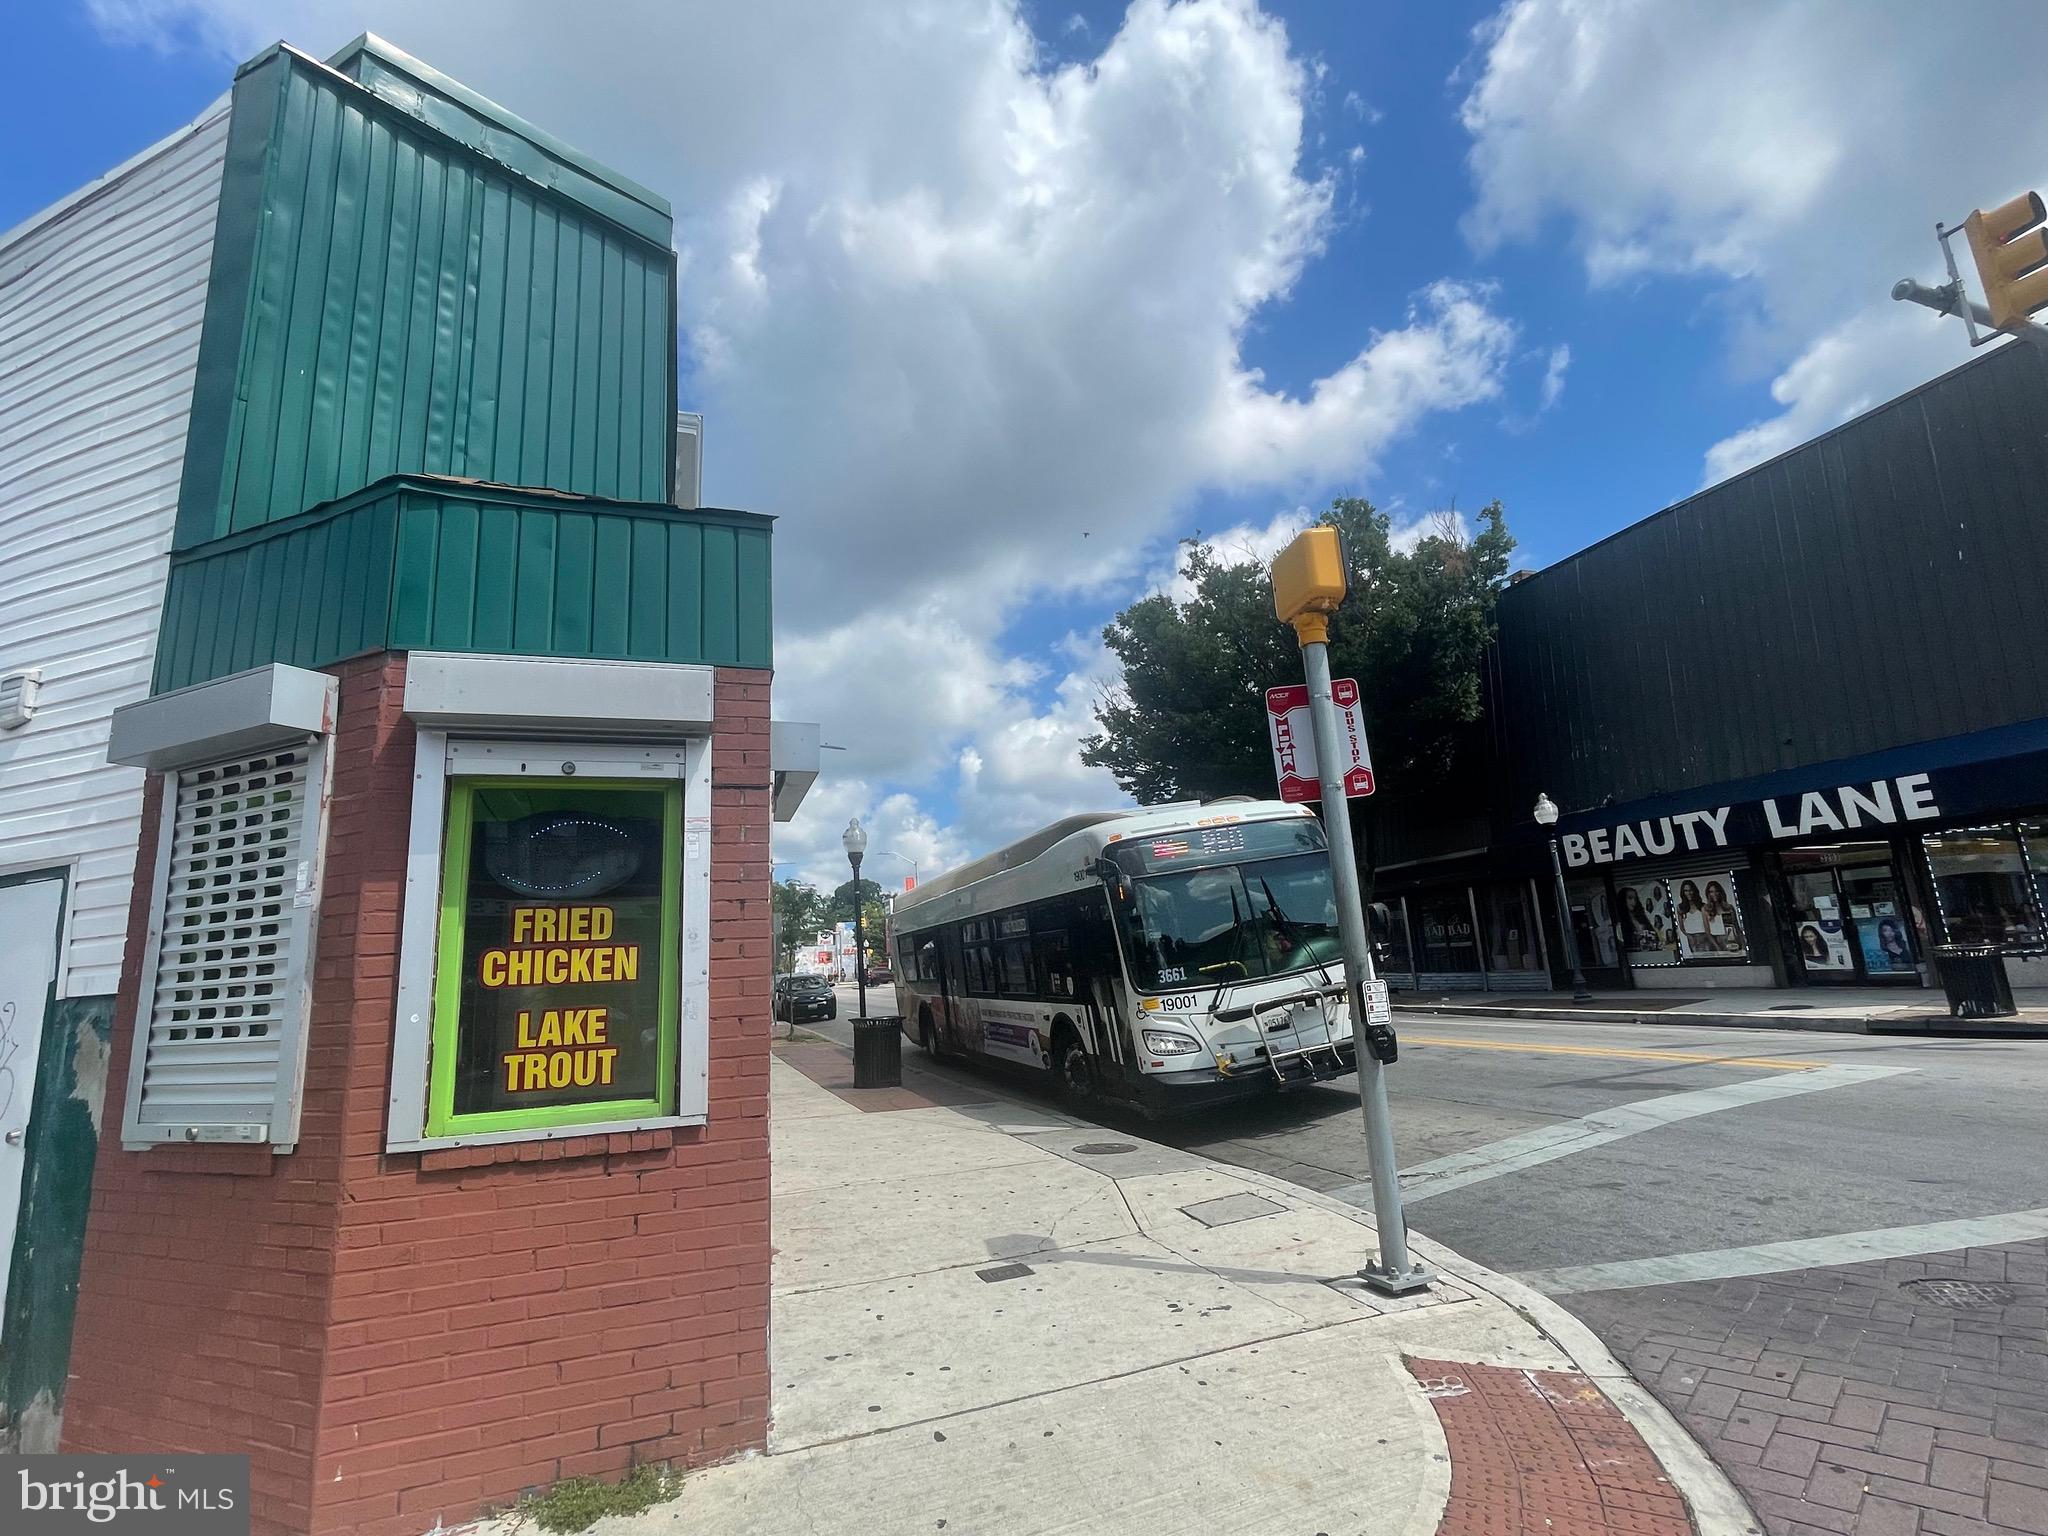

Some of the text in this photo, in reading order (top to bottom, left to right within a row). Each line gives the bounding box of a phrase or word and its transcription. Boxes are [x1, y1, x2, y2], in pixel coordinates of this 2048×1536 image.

[1277, 724, 1294, 767] LINK
[1345, 711, 1361, 763] BUS STOP
[1562, 773, 1941, 867] BEAUTY LANE
[512, 906, 615, 944] FRIED
[481, 945, 639, 987] CHICKEN
[1157, 966, 1187, 983] 3661
[1160, 994, 1198, 1012] 19001
[517, 1007, 608, 1049] LAKE
[503, 1048, 617, 1091] TROUT
